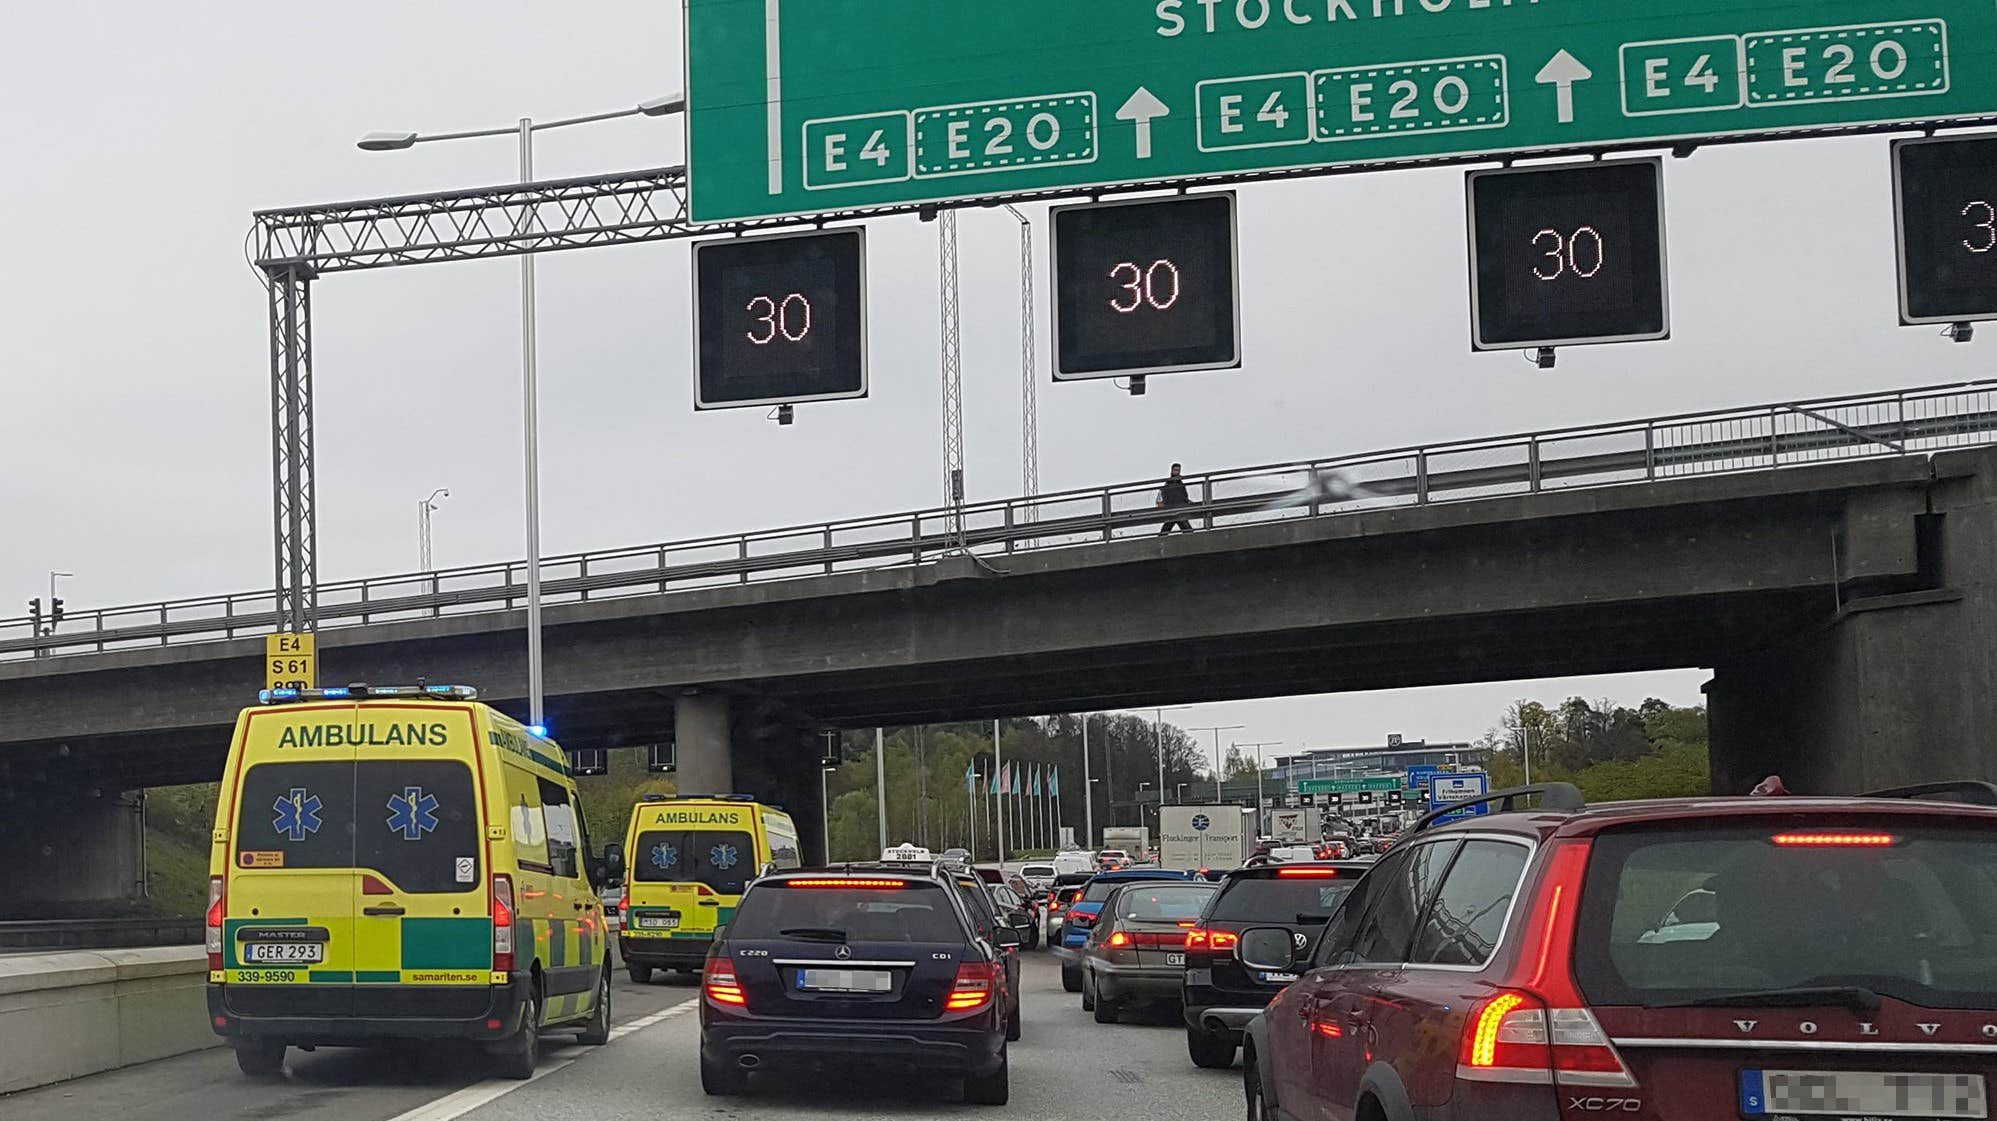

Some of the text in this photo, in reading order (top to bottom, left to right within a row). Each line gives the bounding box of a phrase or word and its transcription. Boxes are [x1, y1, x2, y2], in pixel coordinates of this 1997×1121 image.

[1156, 0, 1540, 37] STOCK
[1643, 40, 1908, 97] E4 E20
[1218, 74, 1470, 133] E4 E20
[825, 112, 1061, 172] E4 E20
[1531, 225, 1602, 281] 30
[1109, 259, 1181, 312] 30
[746, 293, 811, 345] 30
[280, 637, 300, 651] E4
[272, 659, 306, 674] S 61
[278, 723, 448, 749] AMBULANS
[656, 812, 738, 825] AMBULANS
[258, 931, 306, 939] MASTER
[257, 943, 316, 960] GER 293
[237, 970, 296, 983] 339-9590
[412, 973, 478, 982] samariten.se
[1733, 1019, 1997, 1037] VOLVO
[1568, 1096, 1641, 1113] XC70
